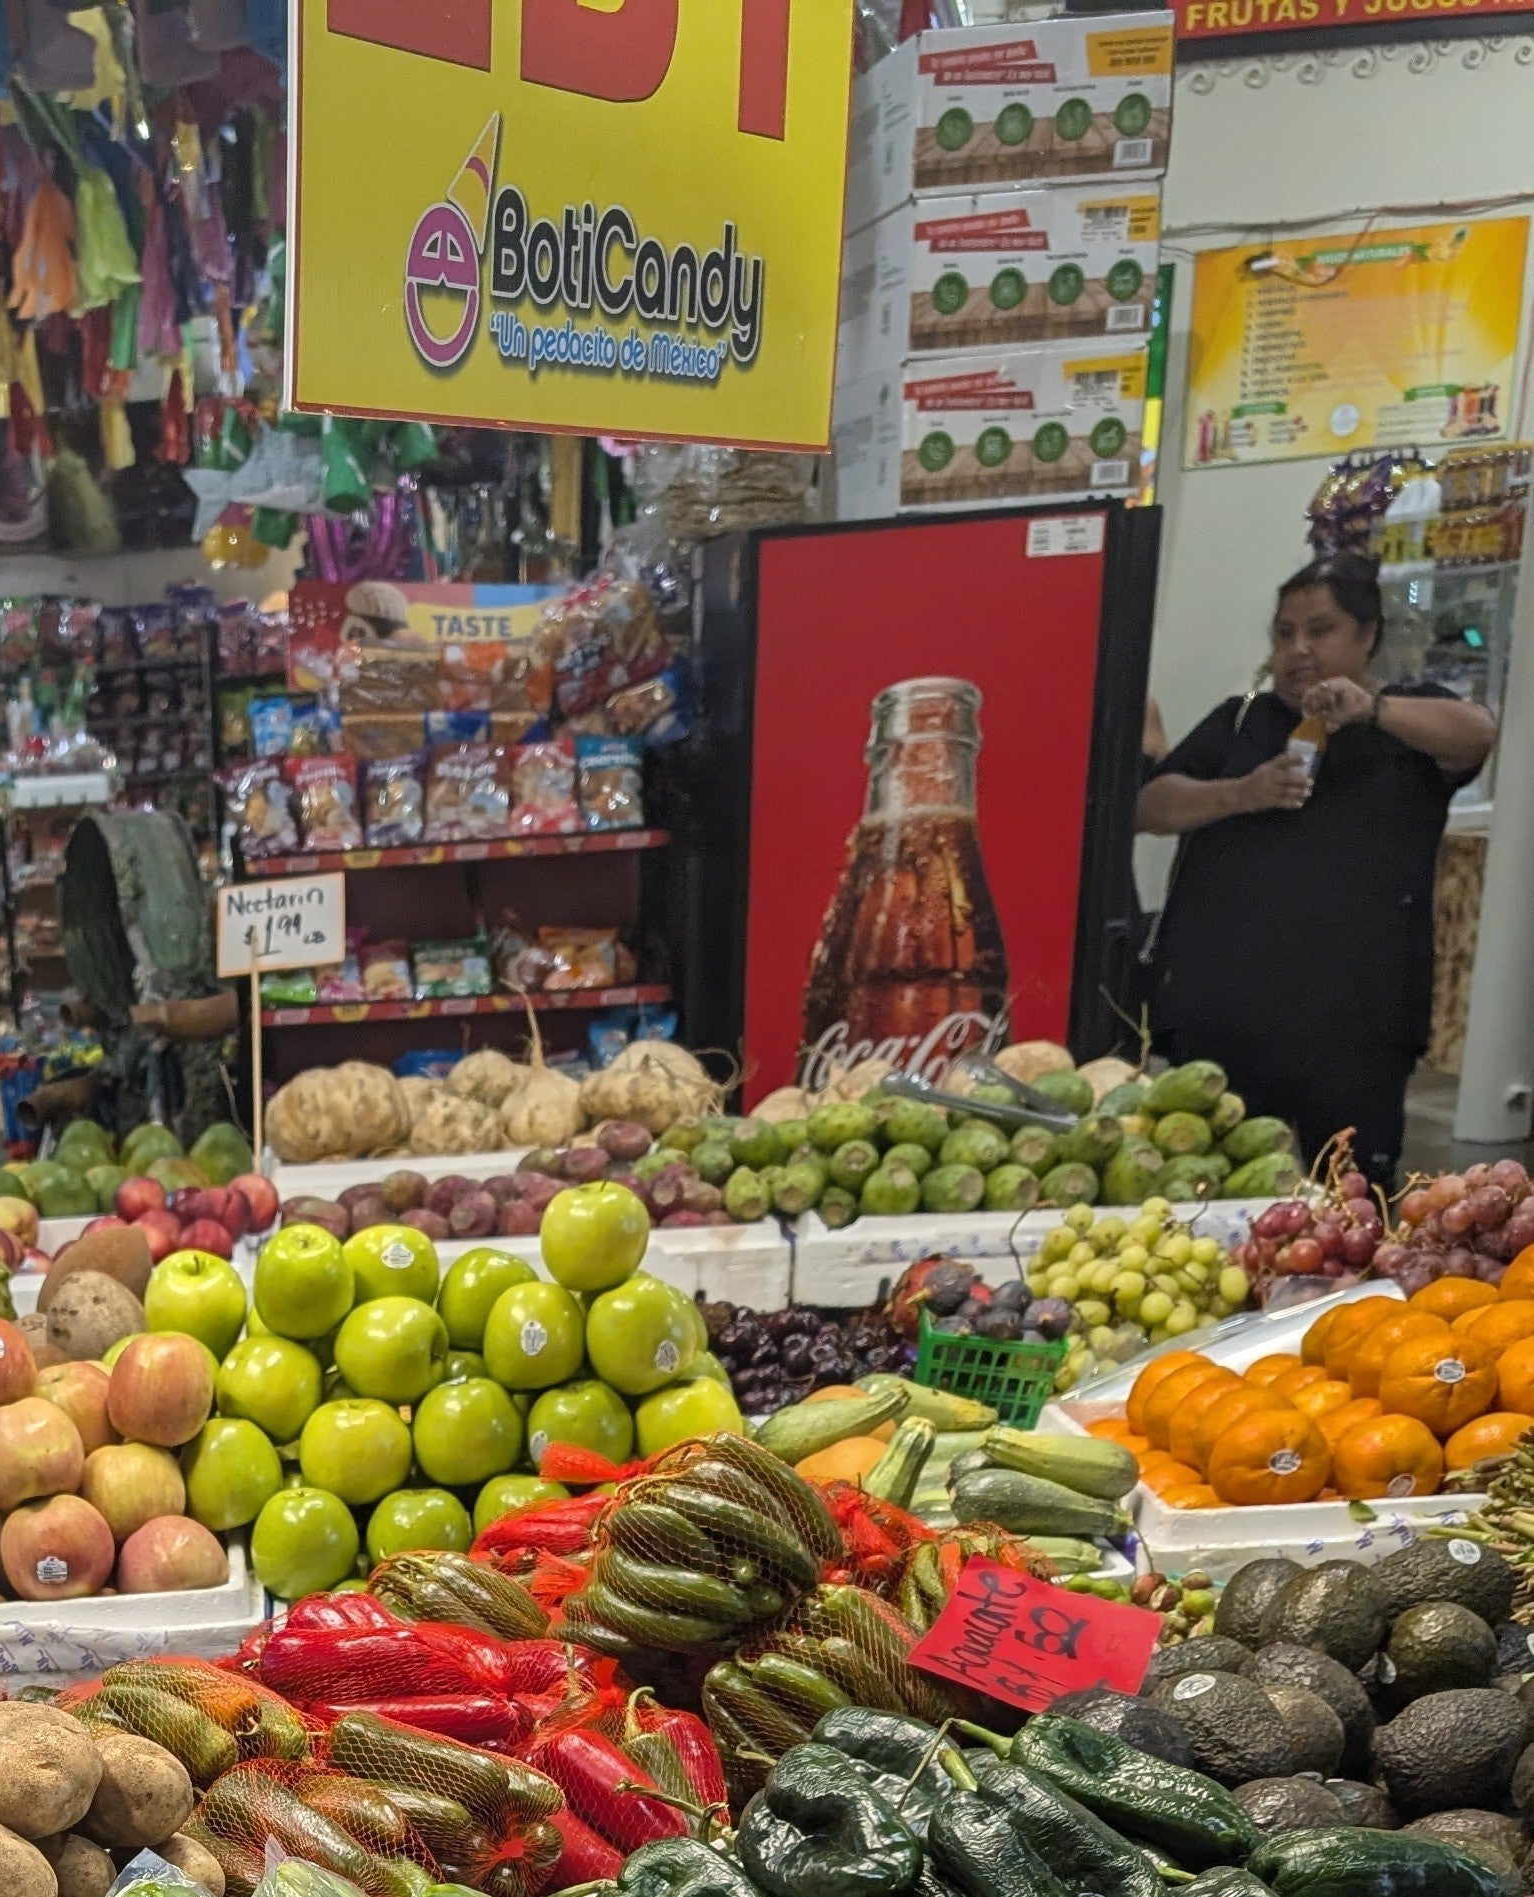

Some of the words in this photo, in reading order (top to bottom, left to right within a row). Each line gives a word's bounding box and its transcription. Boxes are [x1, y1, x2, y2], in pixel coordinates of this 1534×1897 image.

[490, 184, 763, 362] BotiCandy
[529, 318, 617, 370] pedacito
[619, 330, 645, 370] de
[432, 613, 512, 639] TASTE
